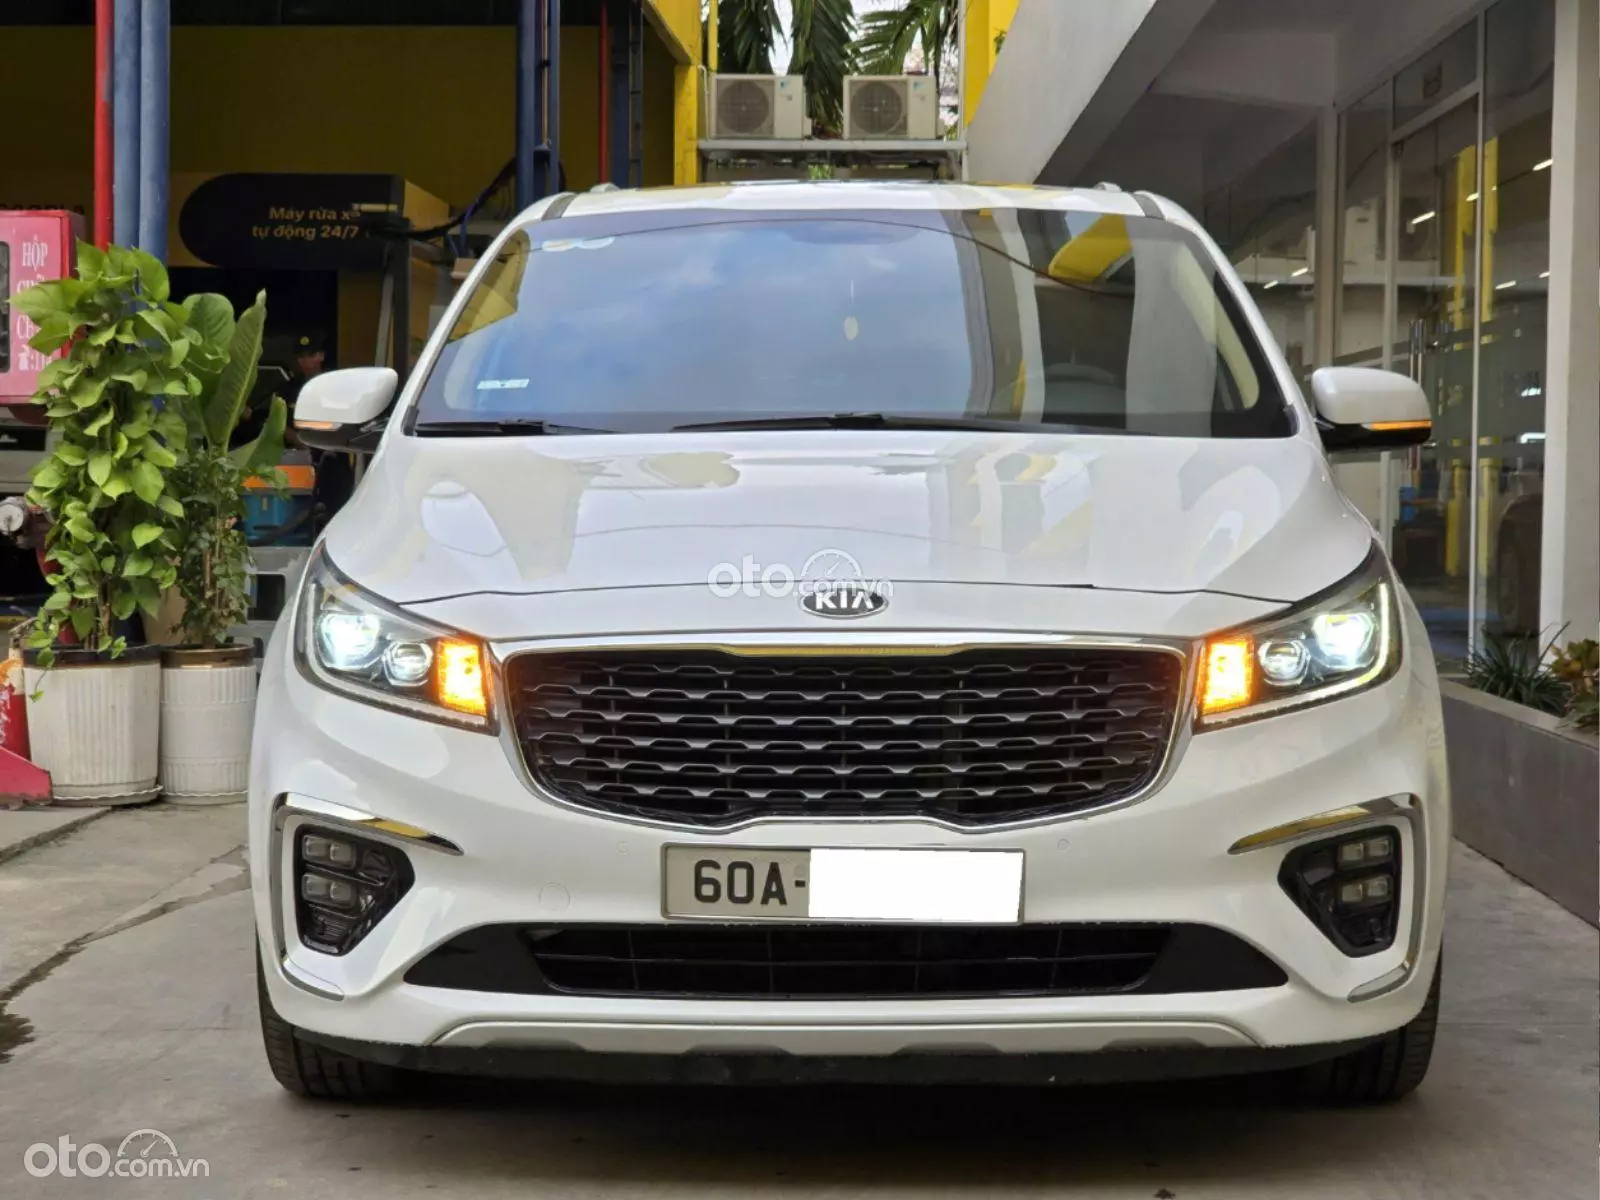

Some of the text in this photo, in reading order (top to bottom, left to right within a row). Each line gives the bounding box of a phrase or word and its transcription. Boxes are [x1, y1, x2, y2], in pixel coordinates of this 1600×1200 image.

[269, 206, 305, 222] Máy
[308, 206, 338, 221] rửa
[251, 224, 360, 241] tự động 24/7
[22, 235, 49, 272] HỘP
[815, 590, 875, 609] KIA
